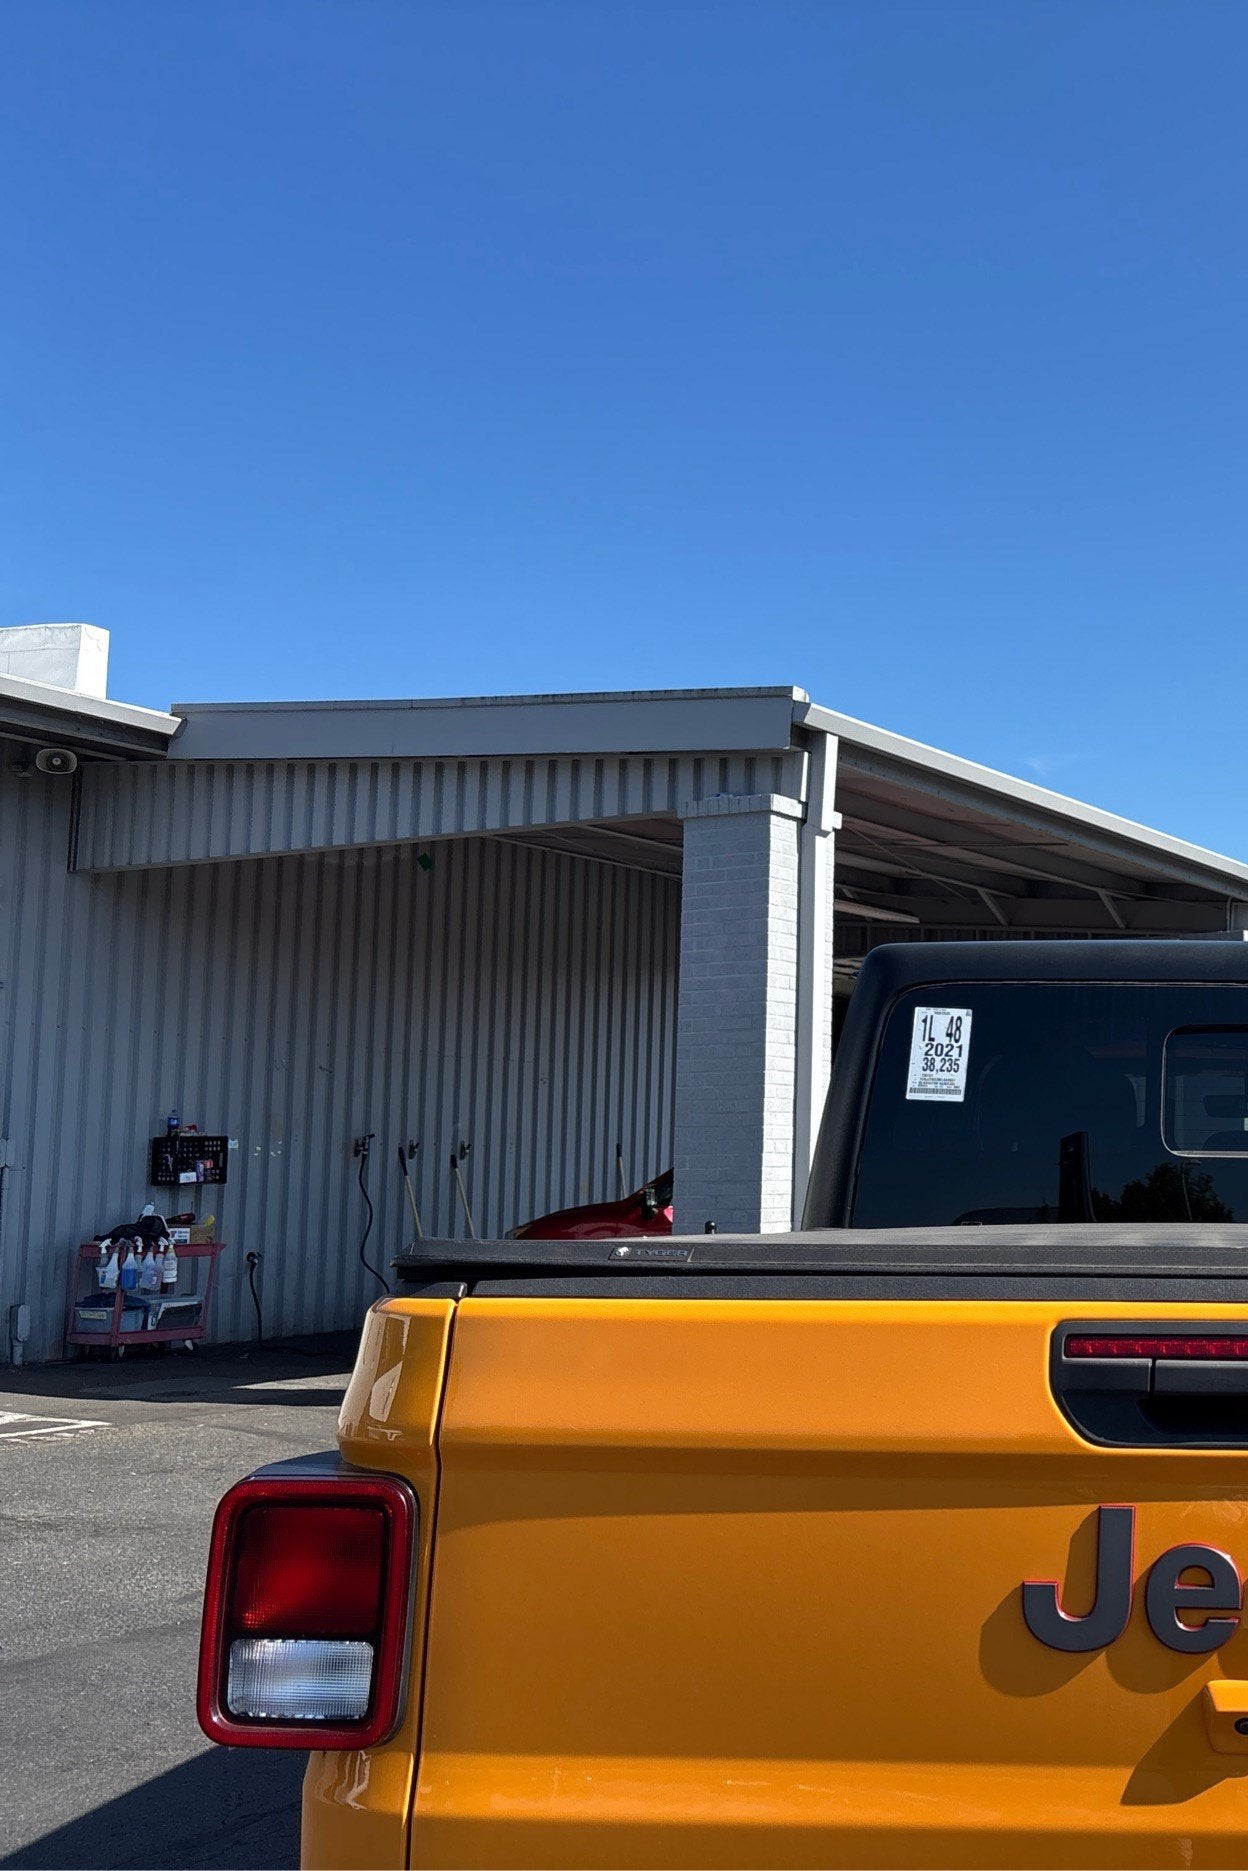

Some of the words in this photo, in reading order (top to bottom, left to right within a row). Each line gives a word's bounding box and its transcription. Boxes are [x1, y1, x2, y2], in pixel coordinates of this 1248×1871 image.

[922, 1015, 935, 1042] 1L
[945, 1016, 962, 1043] 48
[924, 1043, 963, 1057] 2021
[922, 1057, 959, 1074] 38,235
